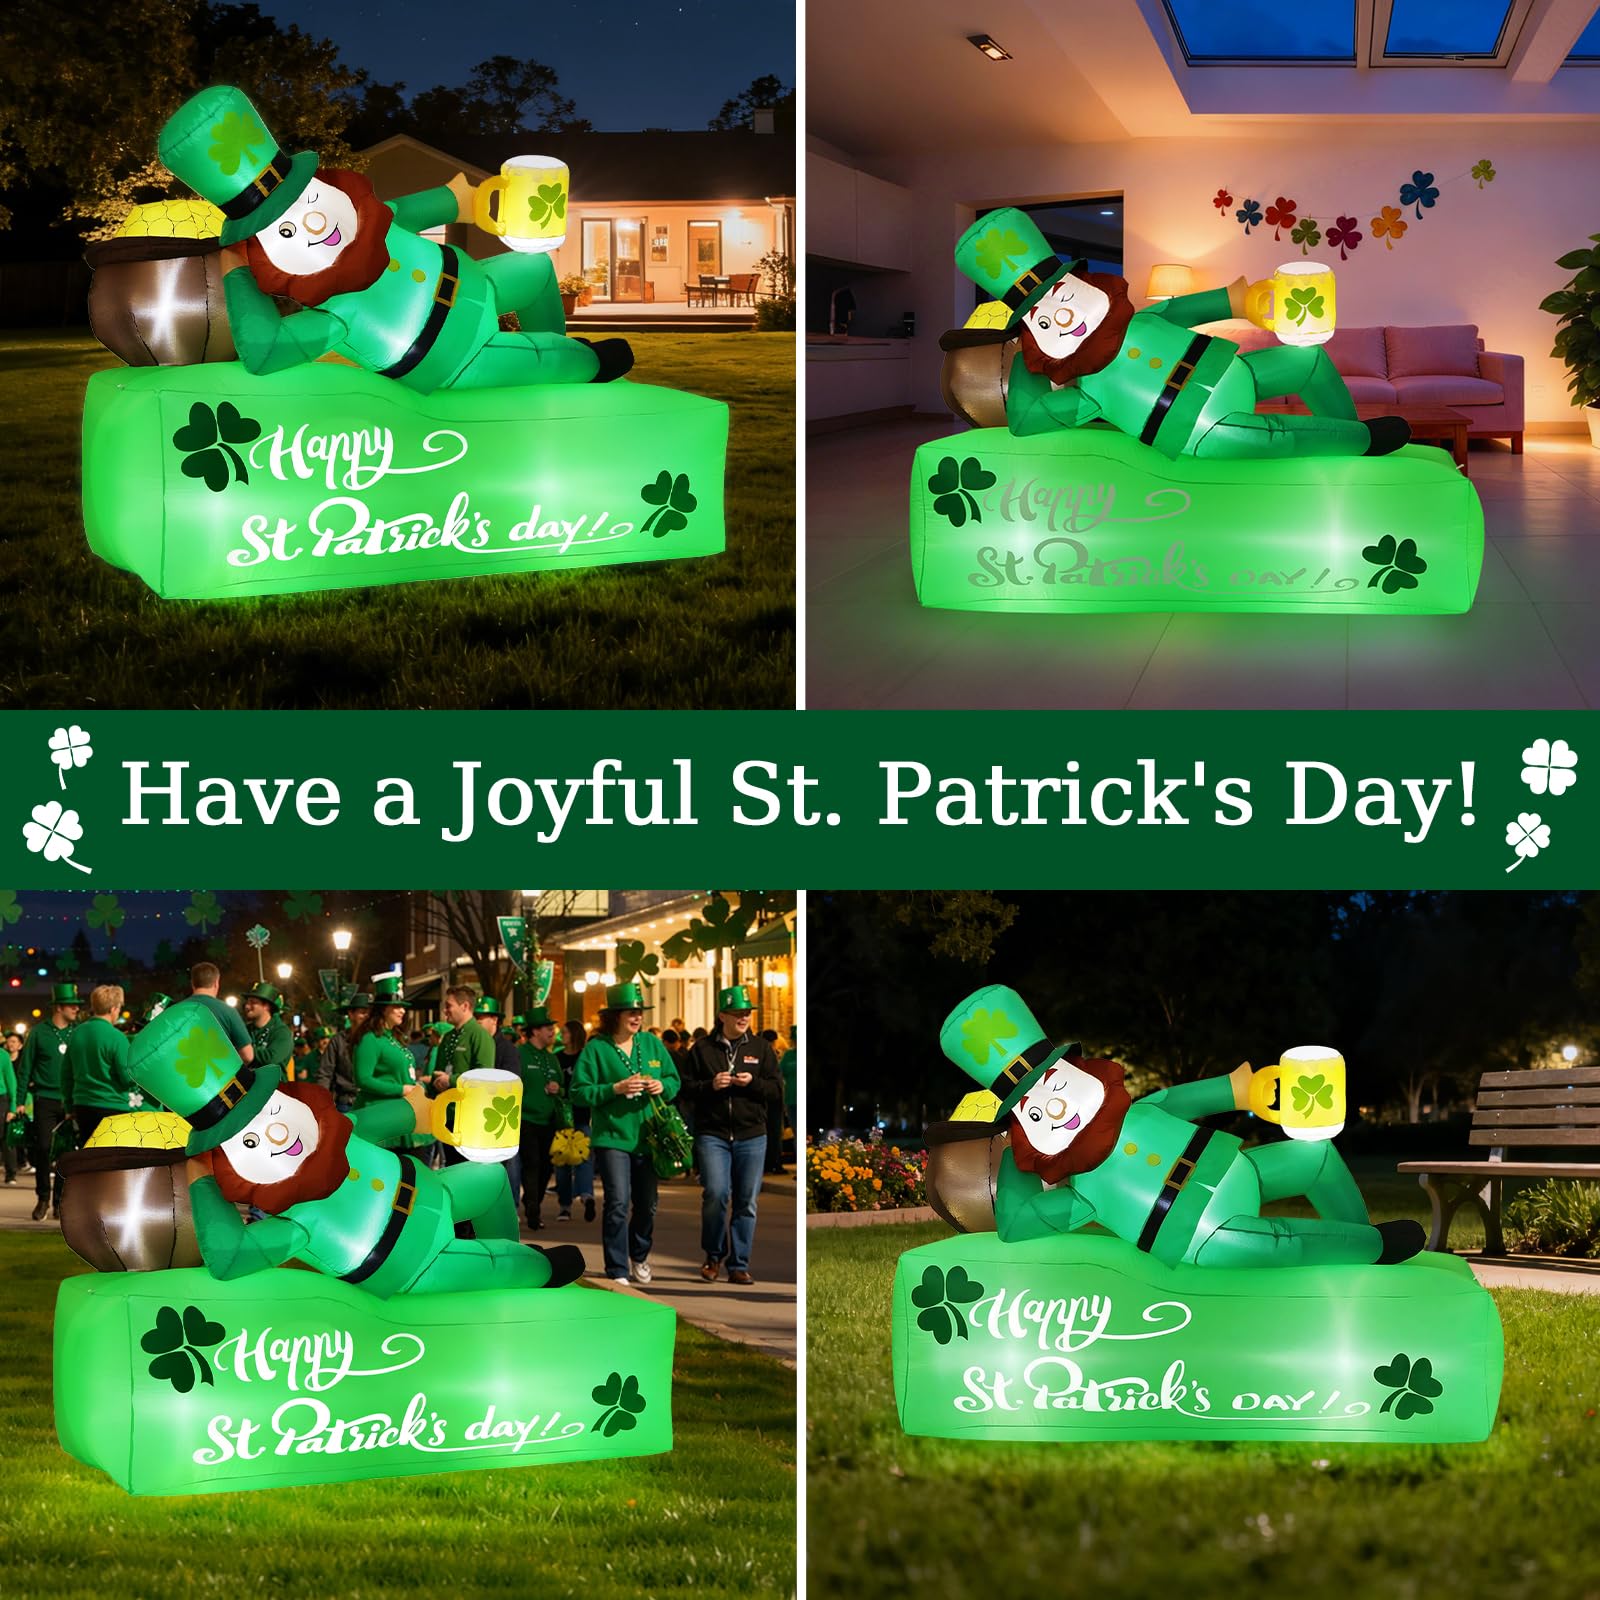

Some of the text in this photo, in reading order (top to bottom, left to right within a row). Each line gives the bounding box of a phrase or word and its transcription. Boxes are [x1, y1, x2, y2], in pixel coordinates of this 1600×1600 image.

[248, 423, 468, 491] Happy
[226, 491, 611, 567] St Patrick's day!
[983, 477, 1192, 533] Happy
[967, 537, 1331, 589] St. Patrick's DAY!
[968, 1288, 1192, 1353] Happy
[213, 1327, 425, 1392] Happy
[954, 1356, 1340, 1414] St. Patrick's DAY!
[192, 1392, 562, 1466] St Patrick's day!
